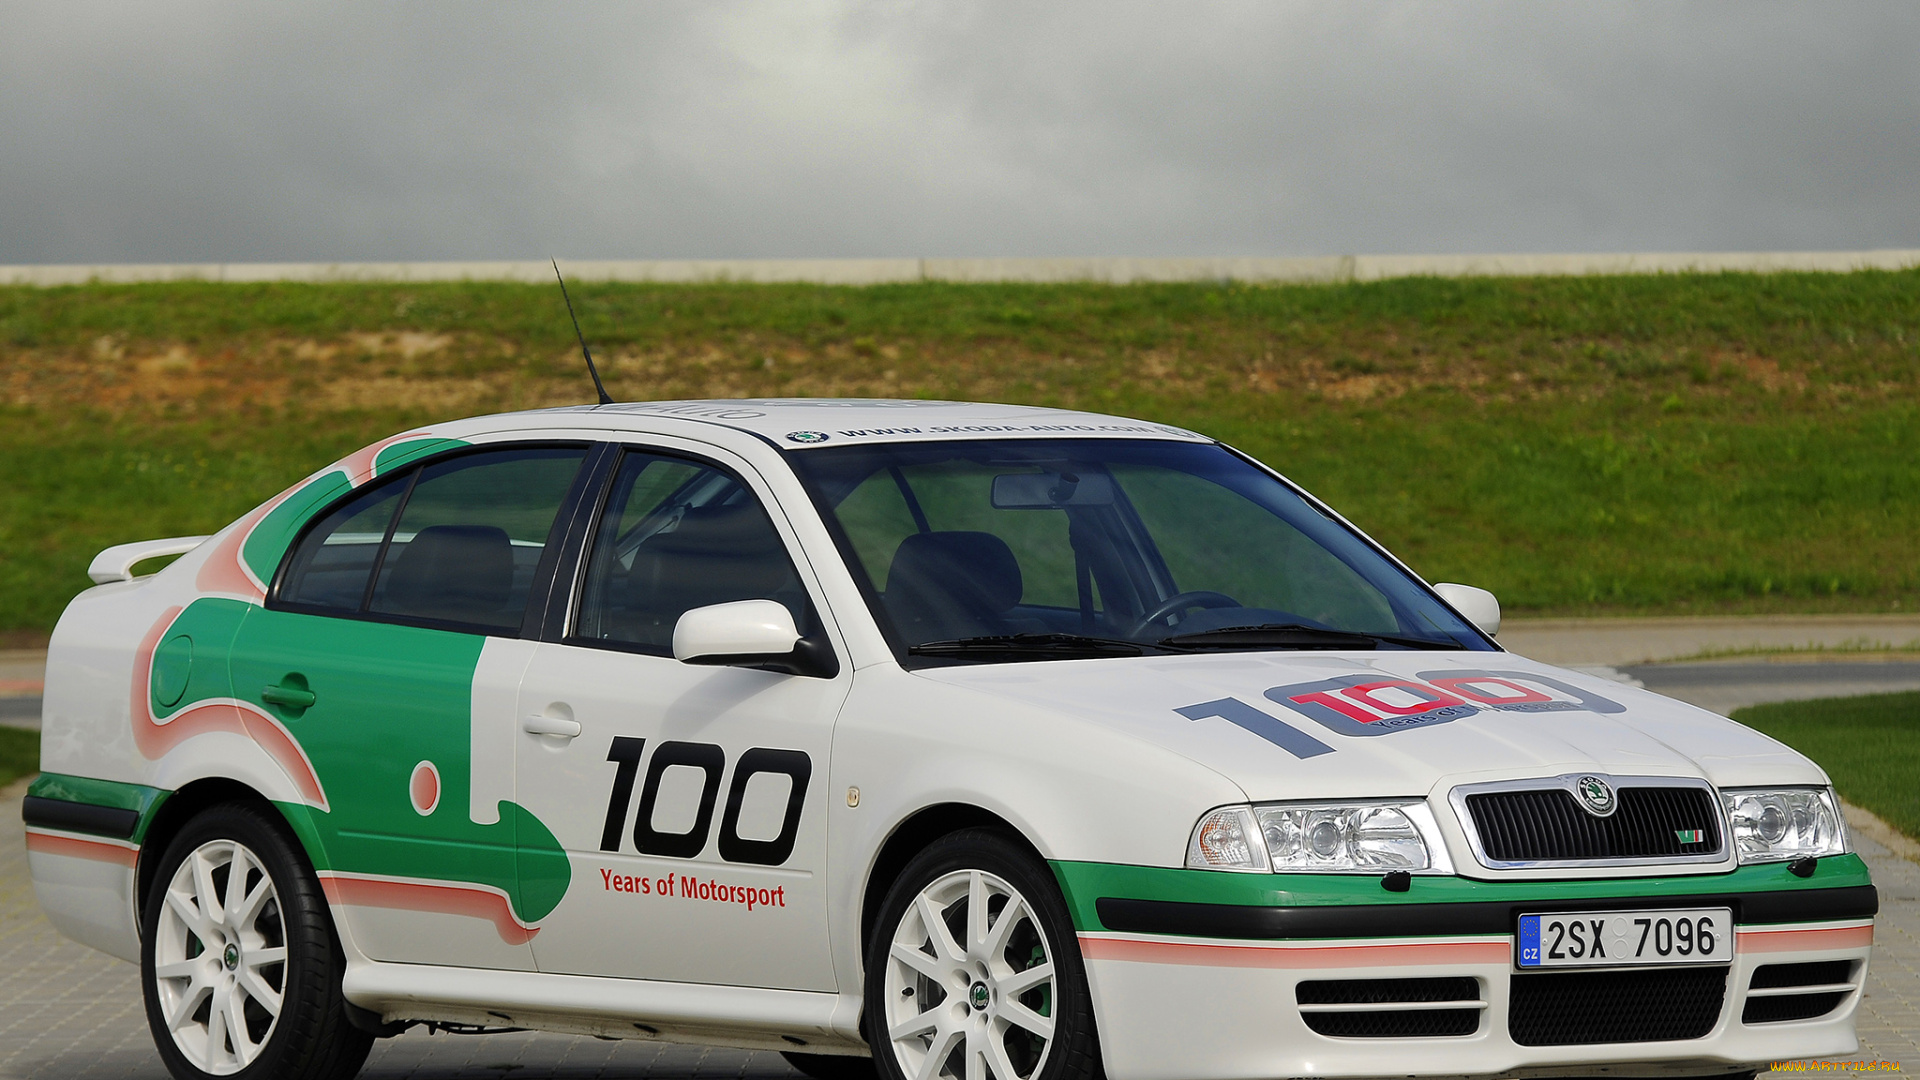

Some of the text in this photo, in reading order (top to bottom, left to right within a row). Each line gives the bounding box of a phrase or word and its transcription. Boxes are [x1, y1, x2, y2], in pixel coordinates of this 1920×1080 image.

[1288, 677, 1553, 725] 100
[1368, 714, 1437, 729] Years
[599, 736, 812, 867] 100
[600, 868, 785, 911] Years of Motorsport
[1523, 948, 1538, 960] CZ
[1548, 917, 1715, 959] 2SX 7096
